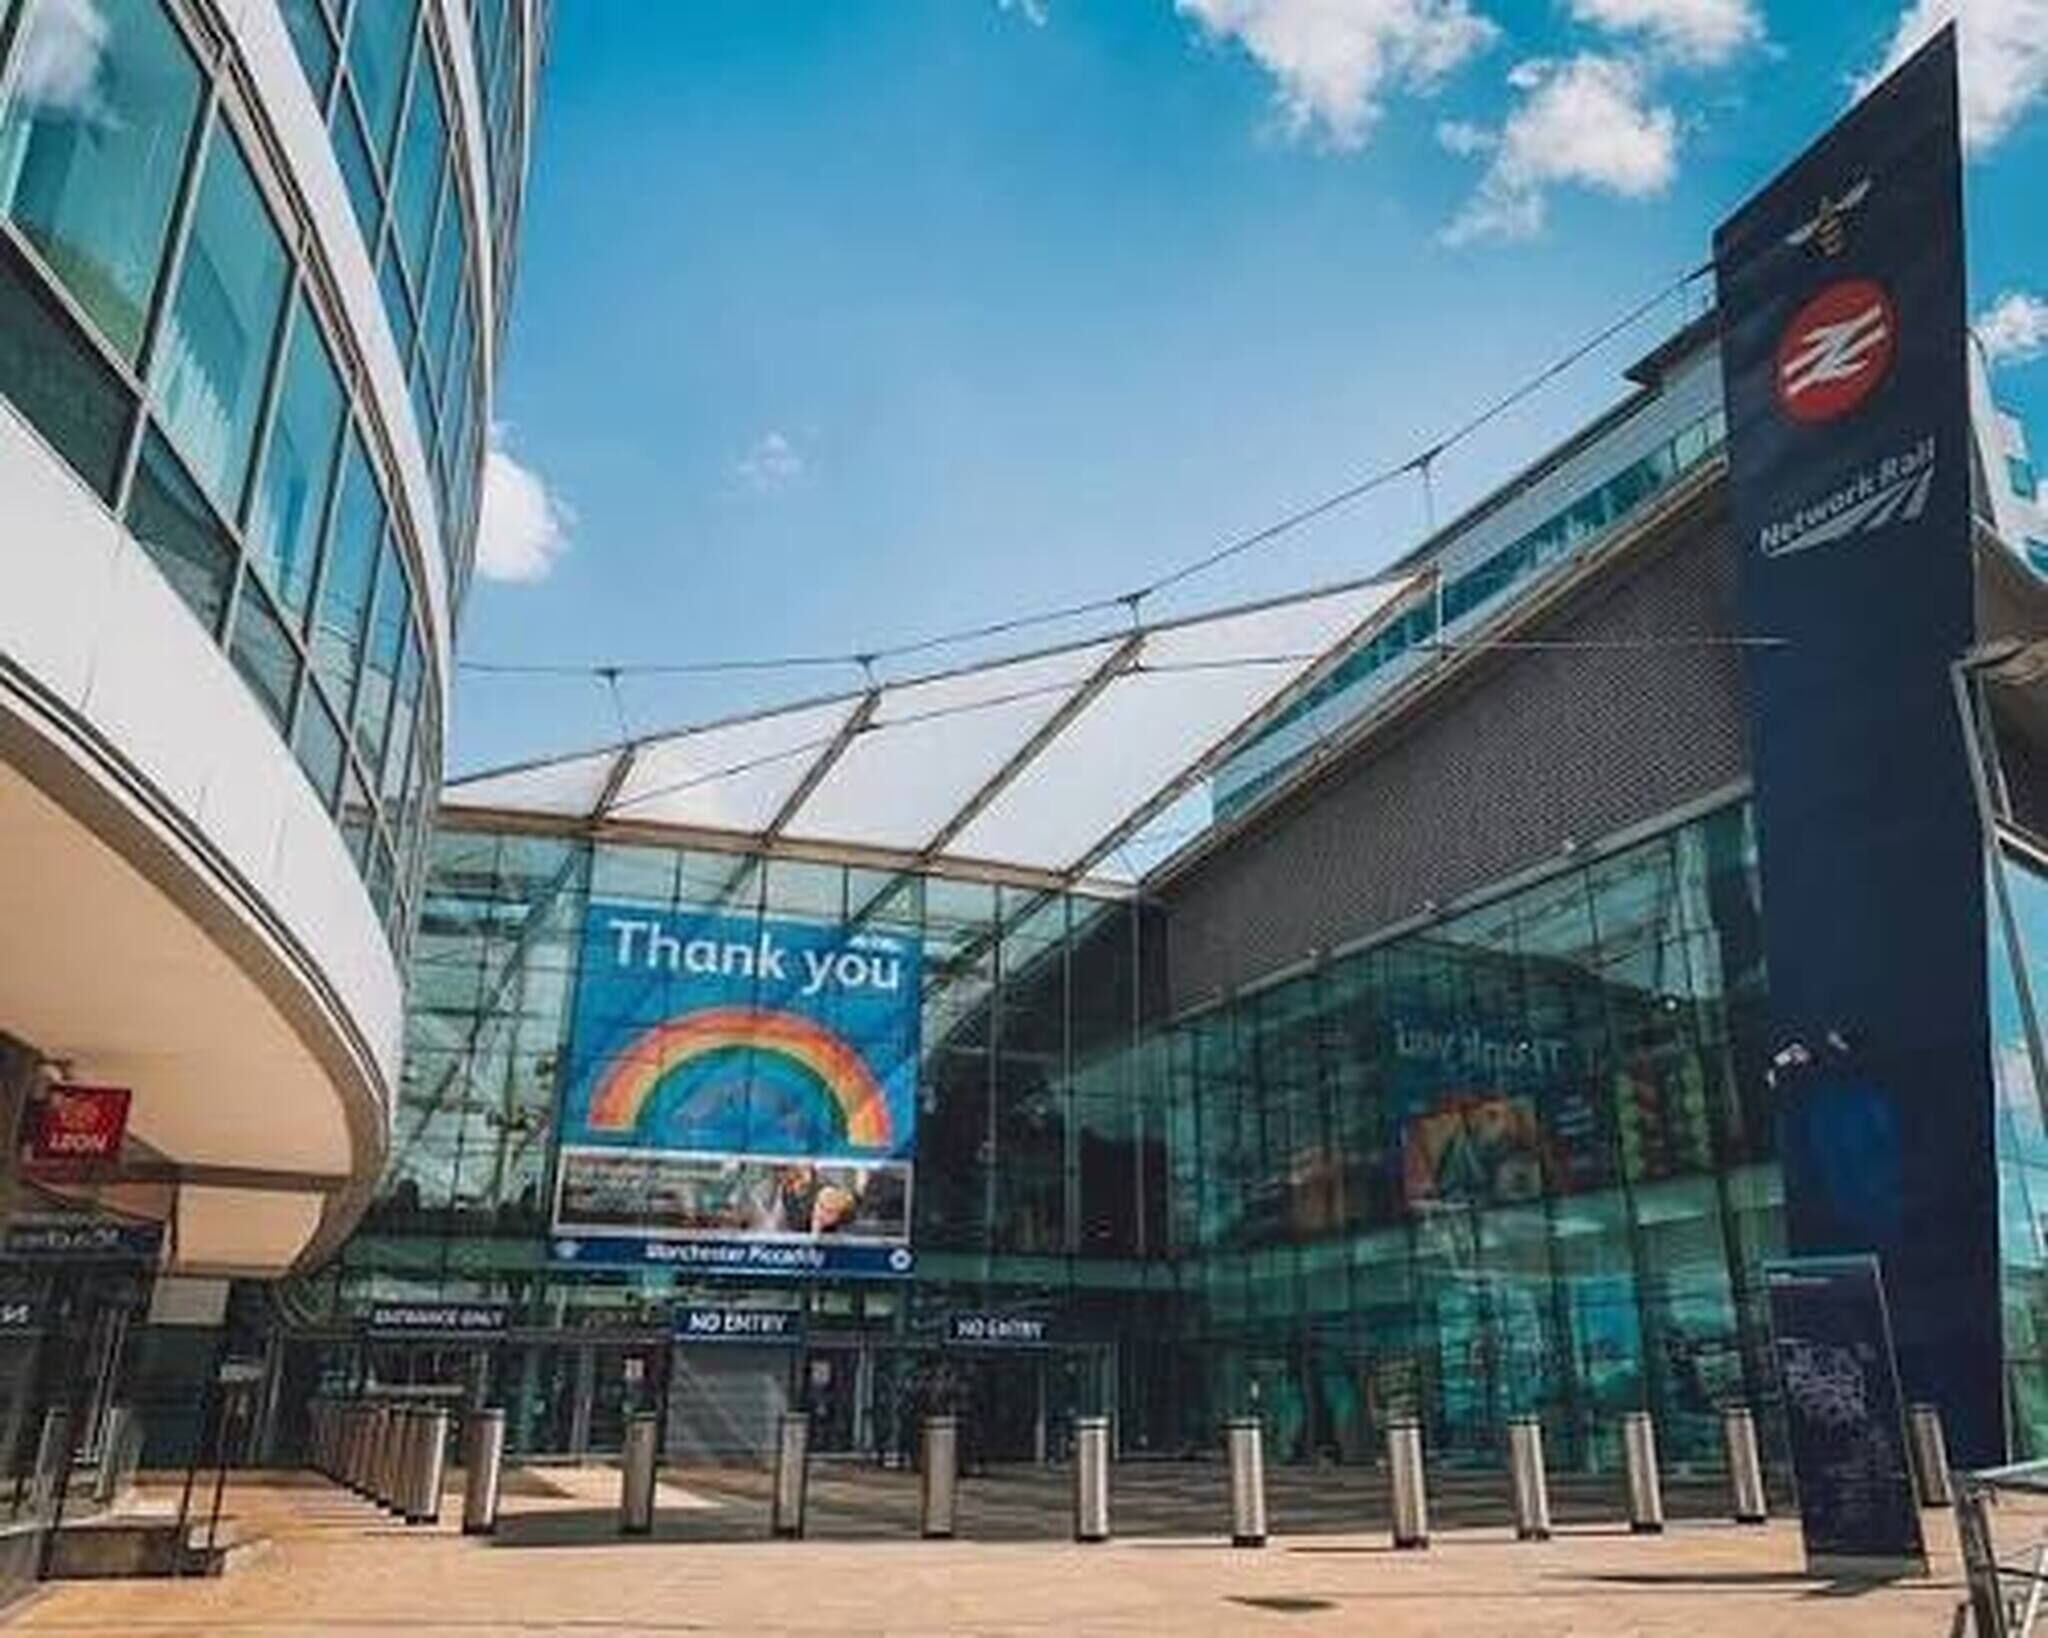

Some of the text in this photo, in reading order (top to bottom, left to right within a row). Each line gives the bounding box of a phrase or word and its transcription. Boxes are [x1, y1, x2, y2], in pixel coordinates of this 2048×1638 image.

[1760, 436, 1936, 553] Network Rail
[608, 918, 899, 994] Thank you
[645, 1243, 827, 1267] Manchester Piccadilly
[689, 1312, 788, 1333] NO ENTRY
[956, 1317, 1044, 1340] NO ENTRY
